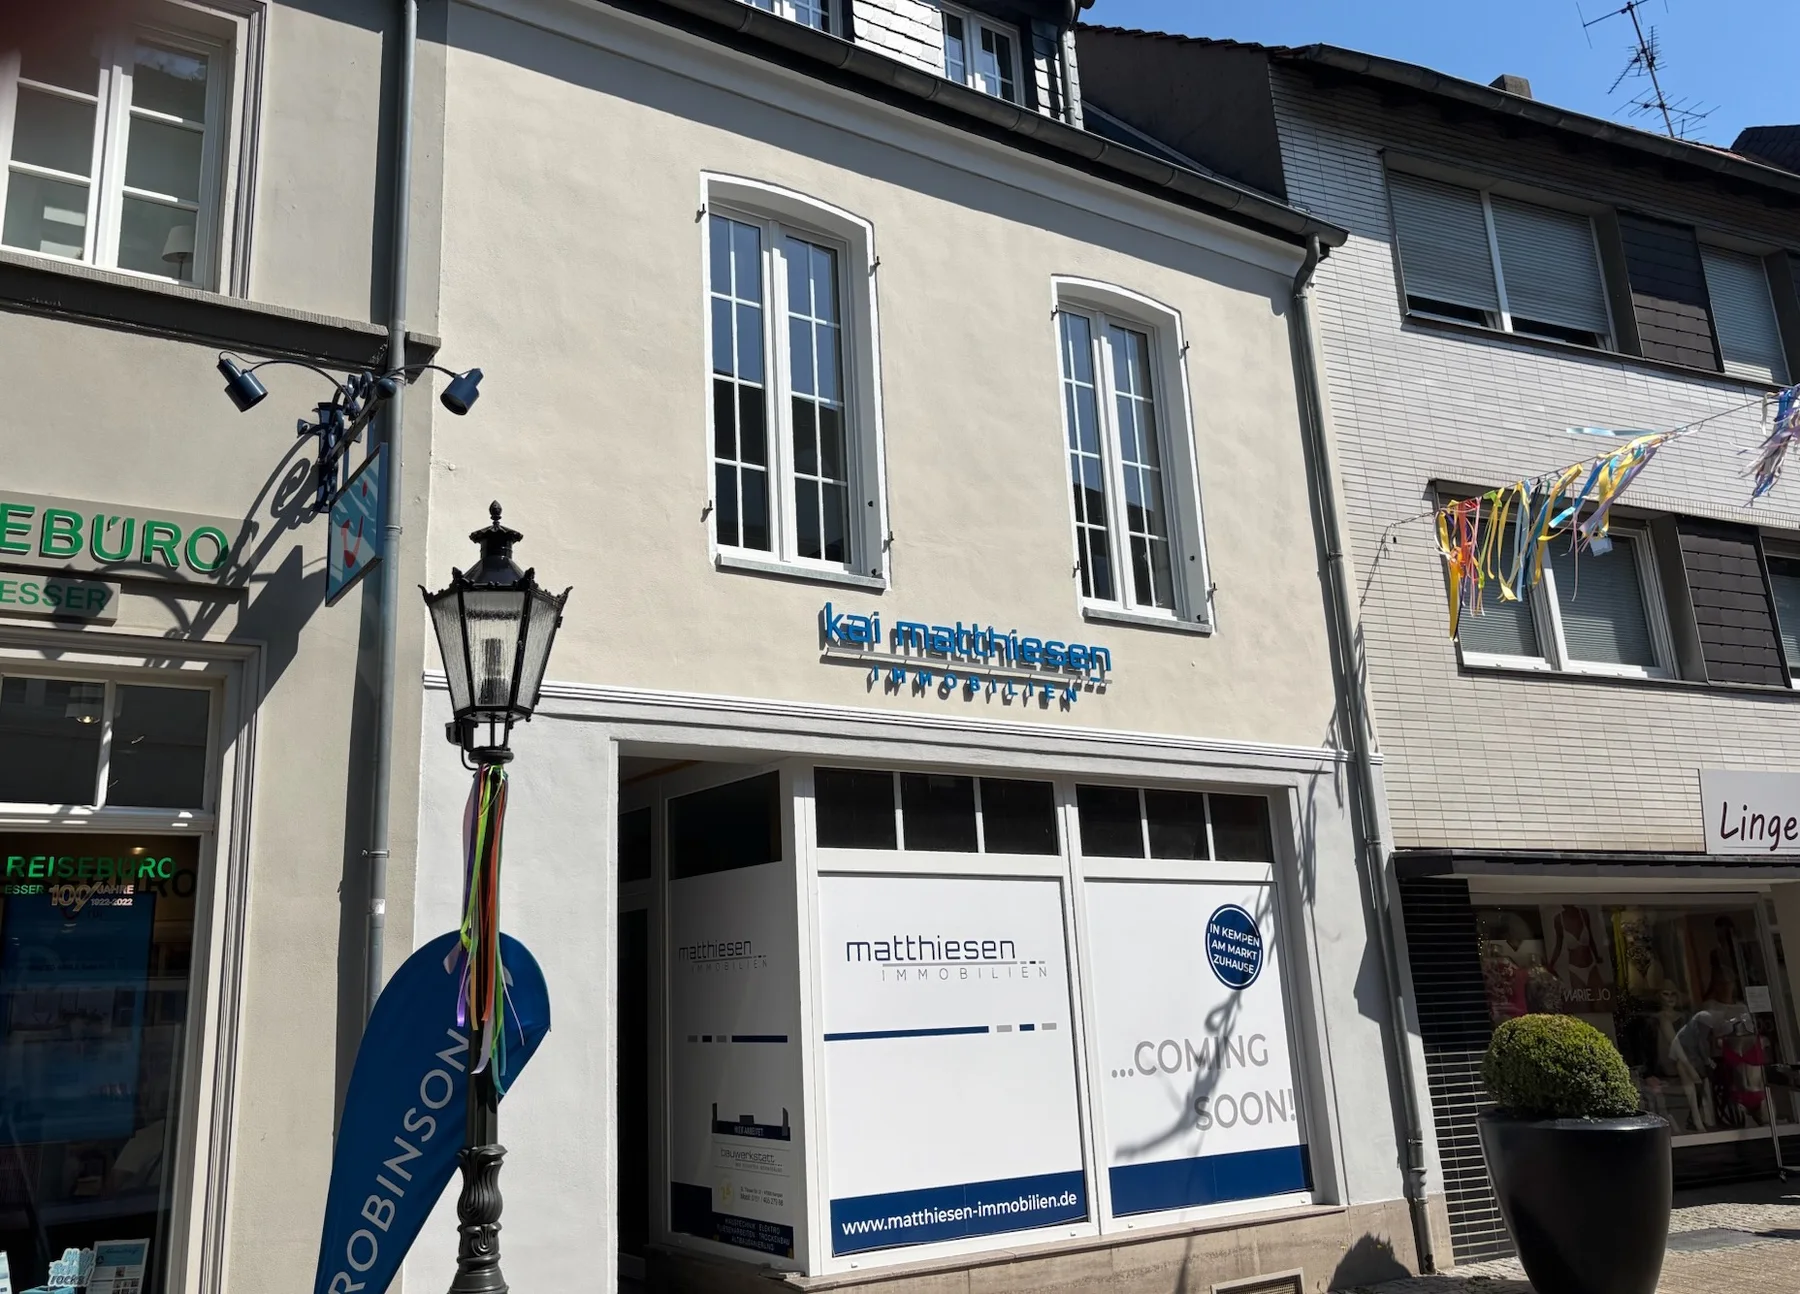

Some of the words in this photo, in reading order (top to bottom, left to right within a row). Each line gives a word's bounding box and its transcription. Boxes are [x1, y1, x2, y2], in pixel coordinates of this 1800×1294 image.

[0, 580, 107, 611] ESSER
[824, 602, 881, 645] kai
[896, 620, 1112, 671] matthiesen
[871, 665, 1078, 703] IMMOBILIEN
[1720, 801, 1799, 852] Linge
[4, 884, 45, 895] ESSER
[98, 884, 135, 895] JAHRE
[1209, 923, 1220, 935] IN
[1222, 927, 1260, 947] KEMPEN
[679, 940, 752, 962] matthiesen
[846, 935, 1016, 961] matthiesen
[1211, 939, 1226, 952] AM
[1227, 944, 1258, 961] MARKT
[691, 959, 768, 974] IMMOBILIEN
[881, 966, 1048, 981] IMMOBILIEN
[1213, 954, 1255, 975] ZUHAUSE
[1194, 1088, 1296, 1131] SOON!
[328, 1028, 470, 1294] ROBINSON
[842, 1190, 1077, 1236] www.matthiesen-immobilien.de
